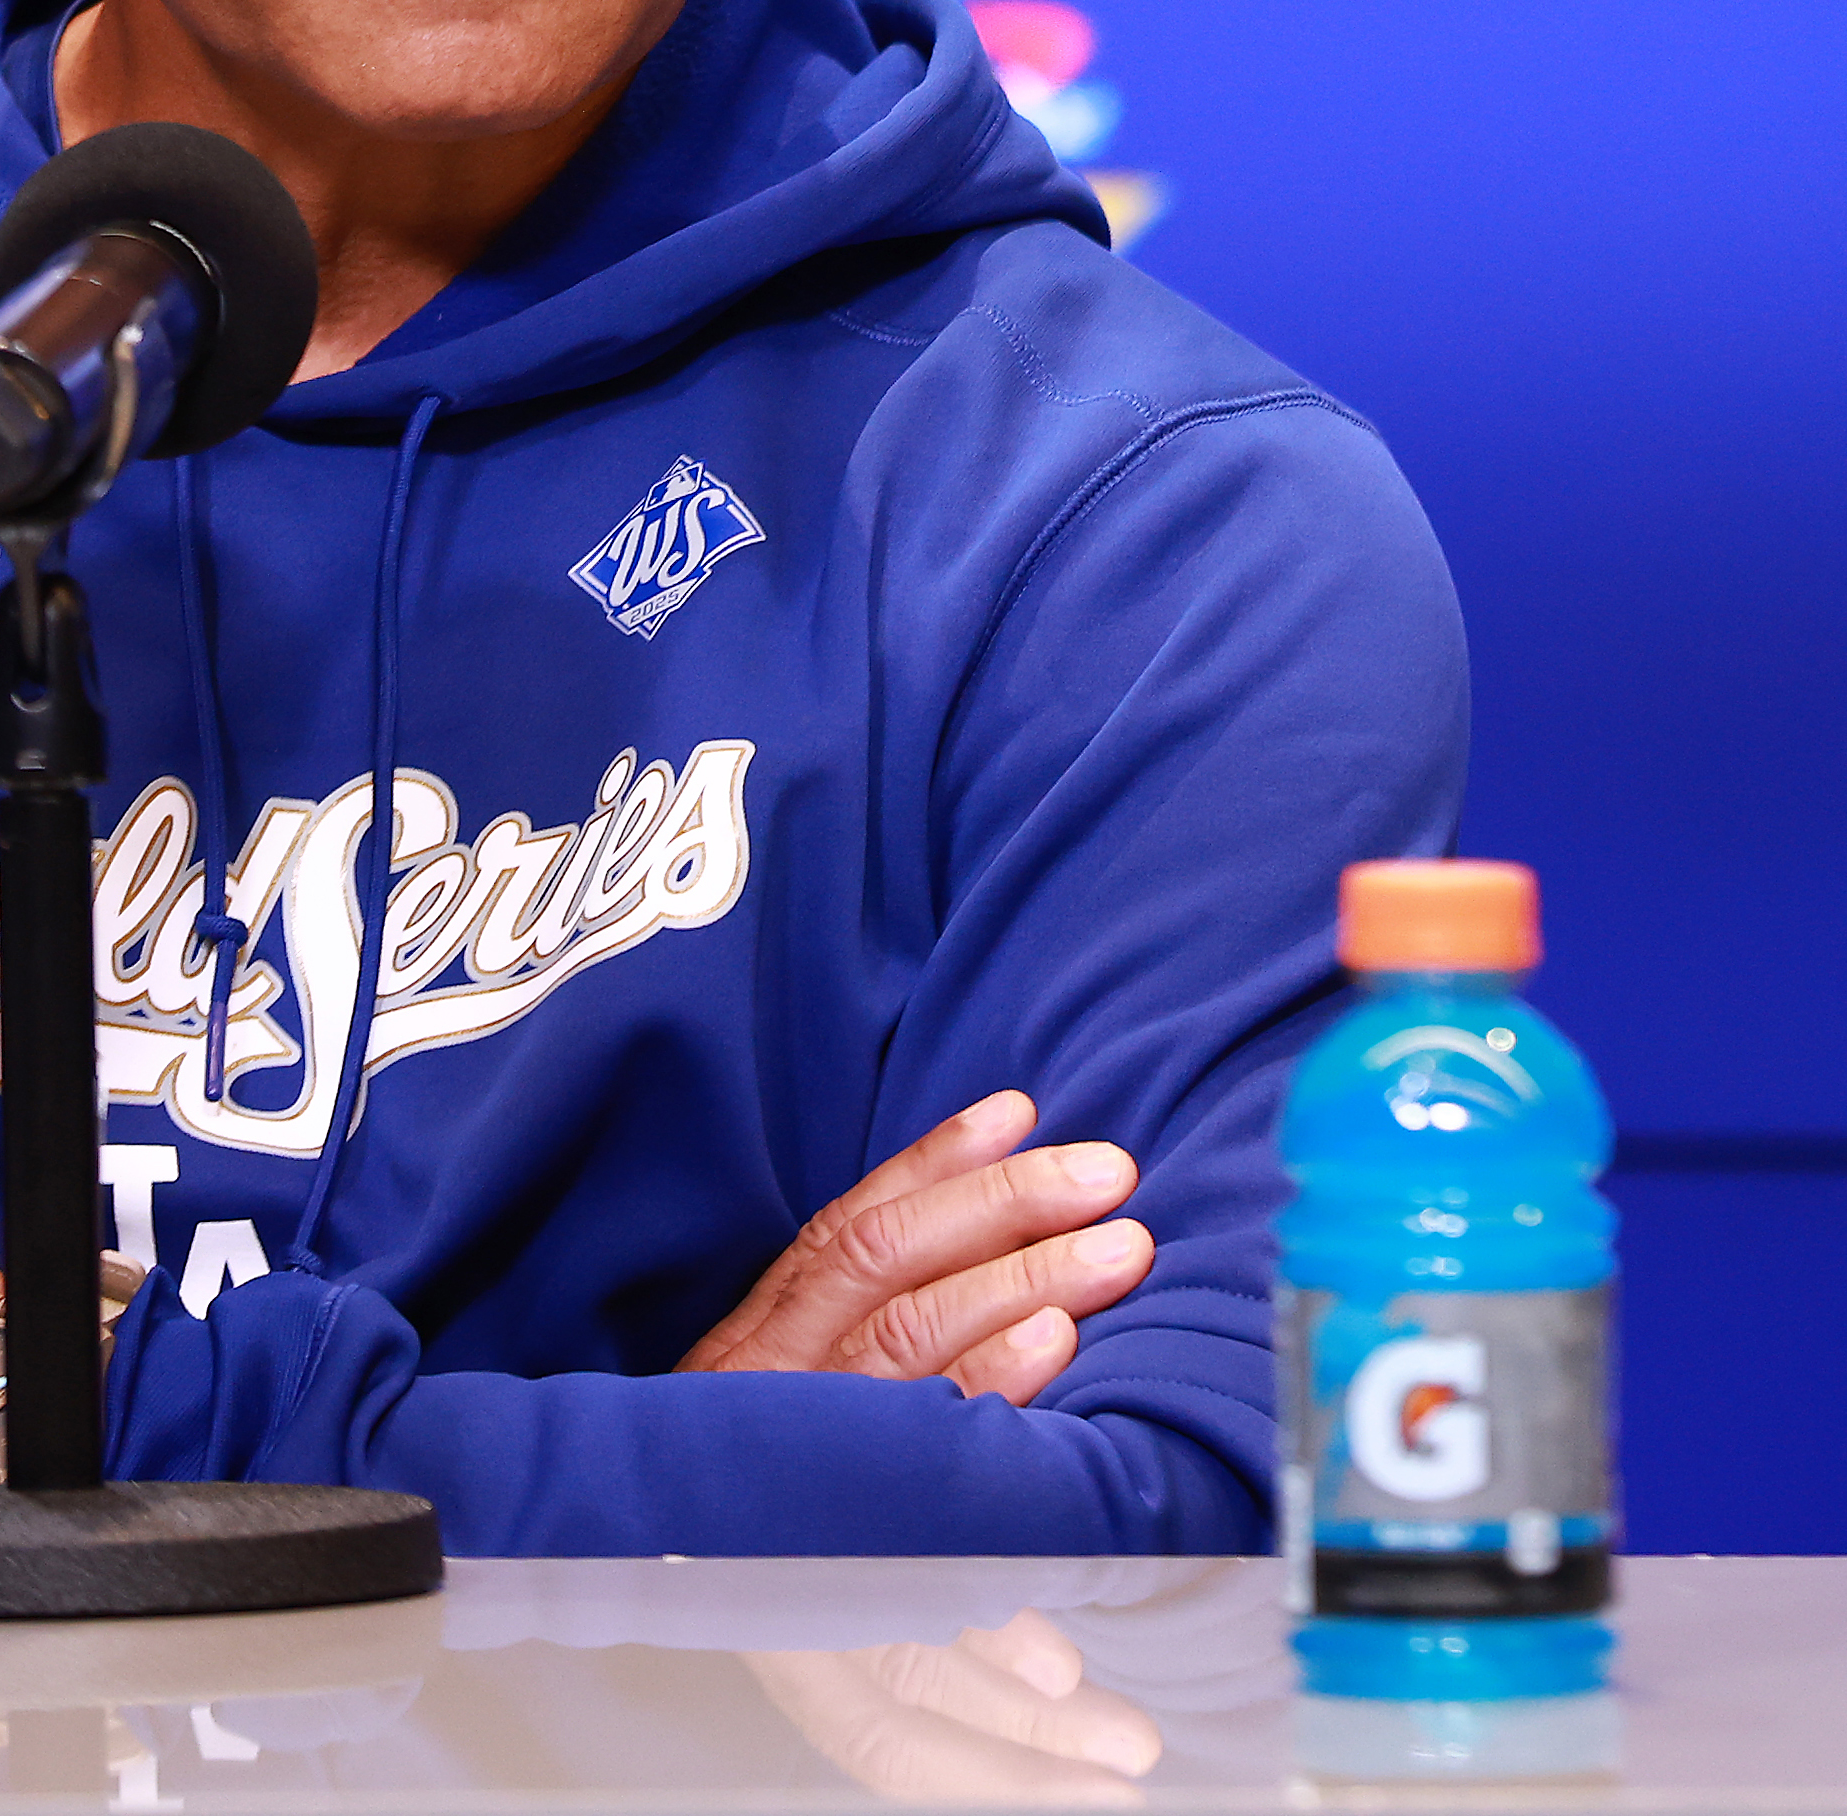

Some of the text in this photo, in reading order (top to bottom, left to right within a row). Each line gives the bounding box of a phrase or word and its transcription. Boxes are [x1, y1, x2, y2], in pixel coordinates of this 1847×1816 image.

[606, 487, 726, 608] WS
[629, 588, 680, 625] 2025
[166, 740, 756, 1160] Series
[1344, 1332, 1491, 1503] G
